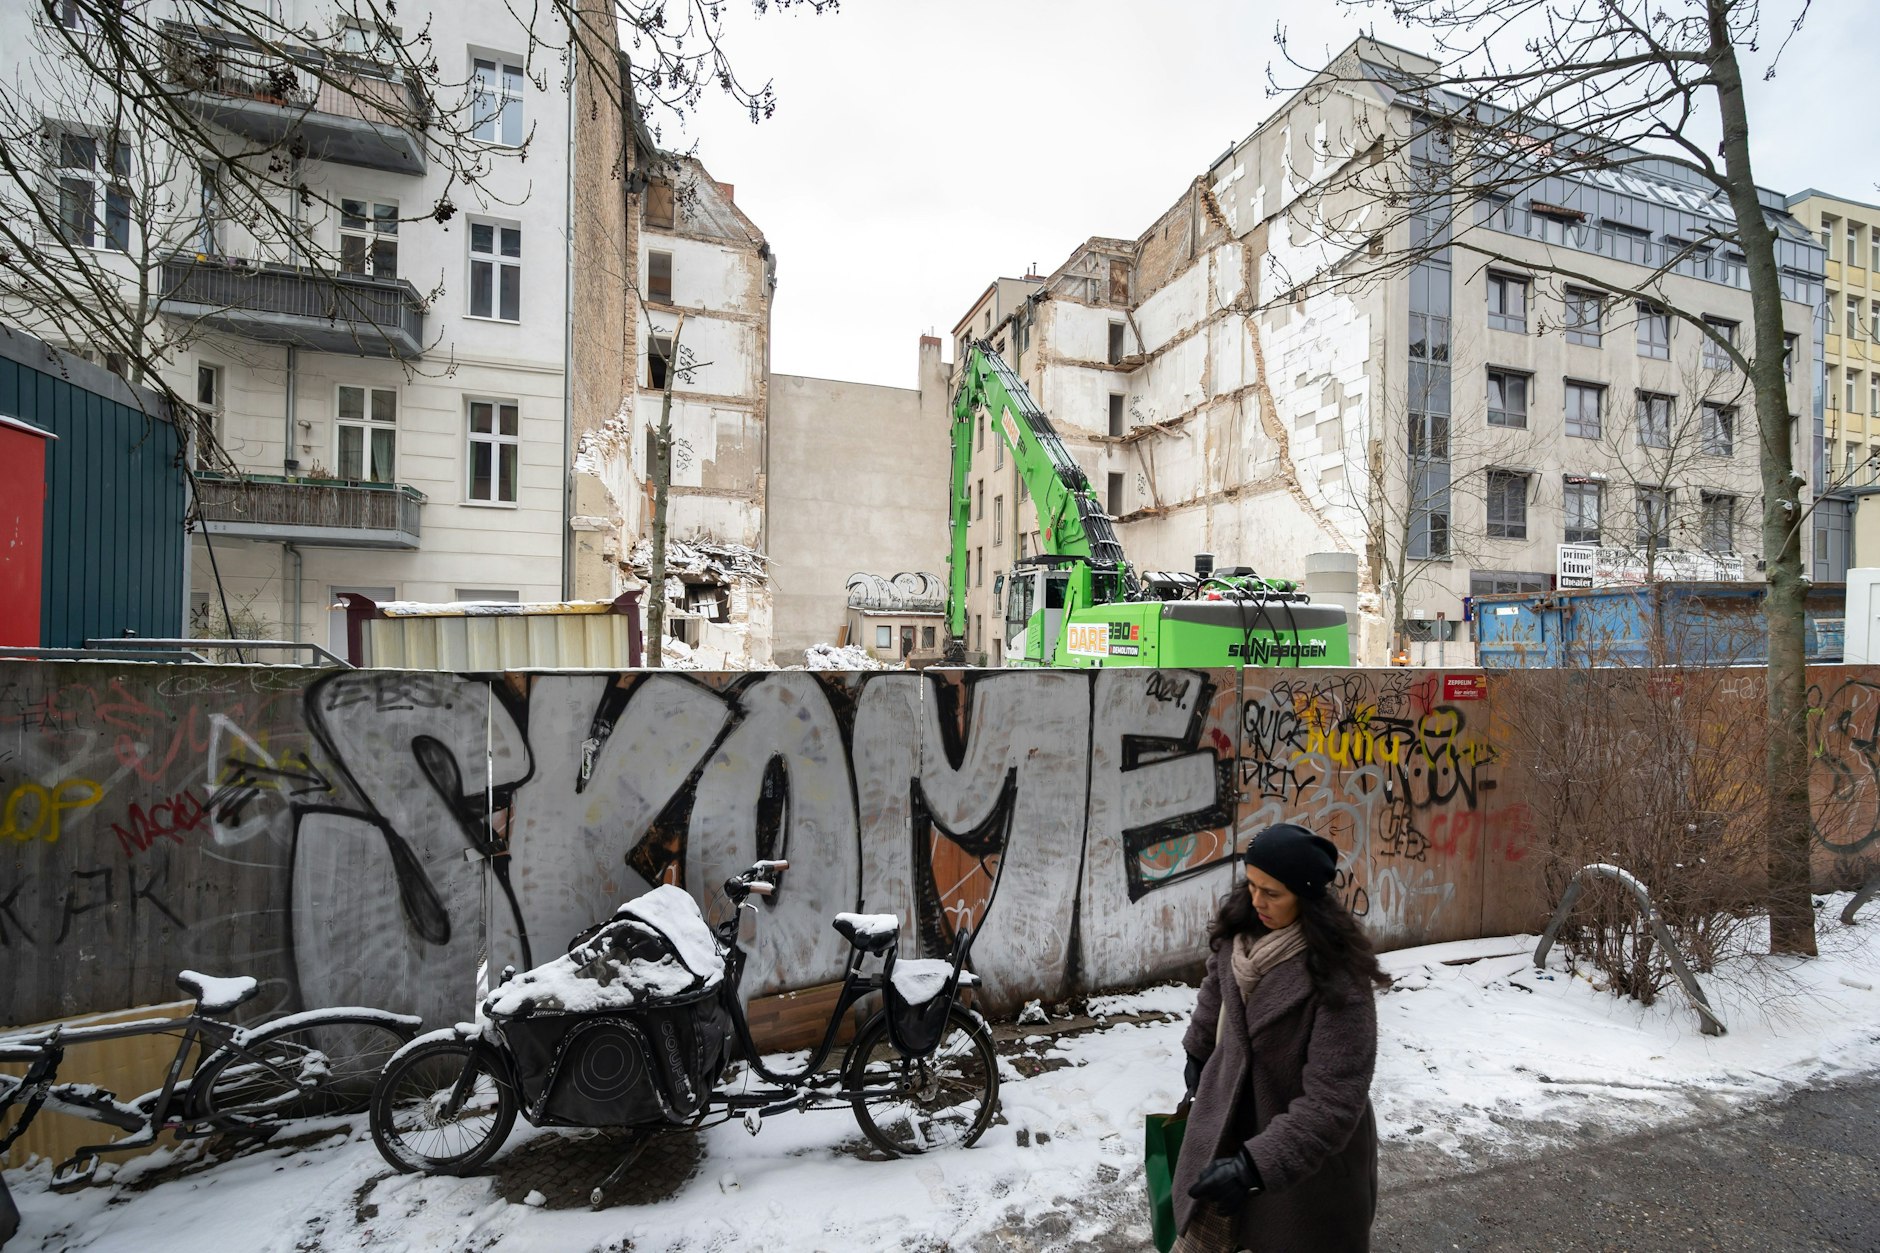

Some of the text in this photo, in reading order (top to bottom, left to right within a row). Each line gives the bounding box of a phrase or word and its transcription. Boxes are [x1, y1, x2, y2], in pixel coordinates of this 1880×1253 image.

[1563, 550, 1591, 560] prime
[1563, 561, 1591, 574] time
[1562, 577, 1592, 588] theater
[1069, 626, 1108, 654] DARE
[1112, 645, 1139, 656] DEMOLITION
[1239, 756, 1316, 807] DIRTY
[661, 1020, 687, 1094] COUPE
